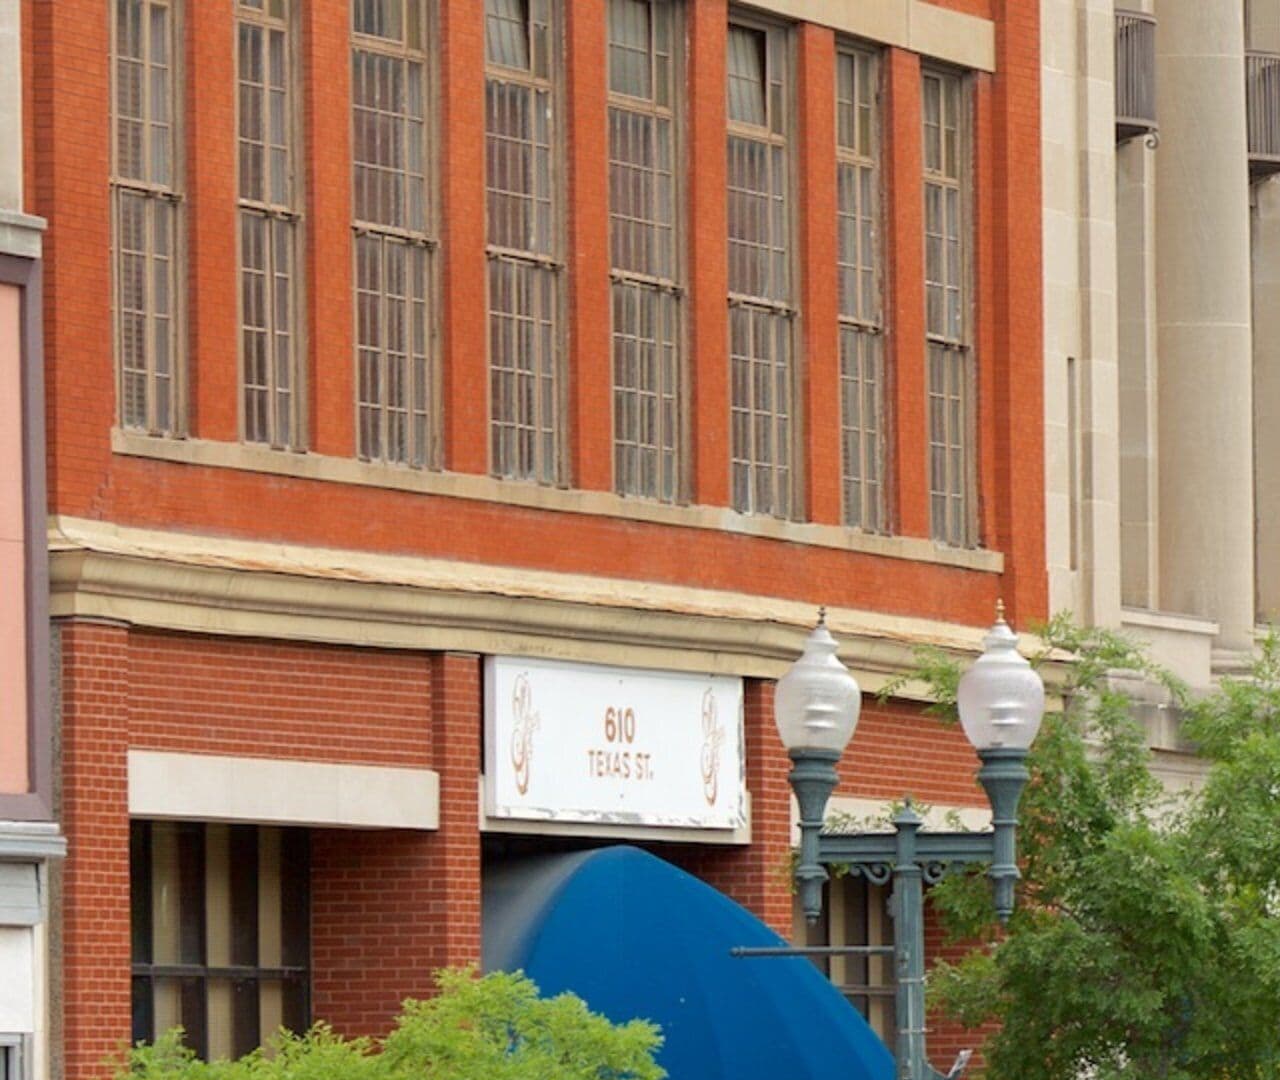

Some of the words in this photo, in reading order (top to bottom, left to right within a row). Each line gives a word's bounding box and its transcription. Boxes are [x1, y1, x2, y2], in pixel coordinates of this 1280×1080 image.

[604, 706, 636, 744] 610
[587, 749, 632, 779] TEXAS
[635, 751, 654, 780] ST.
